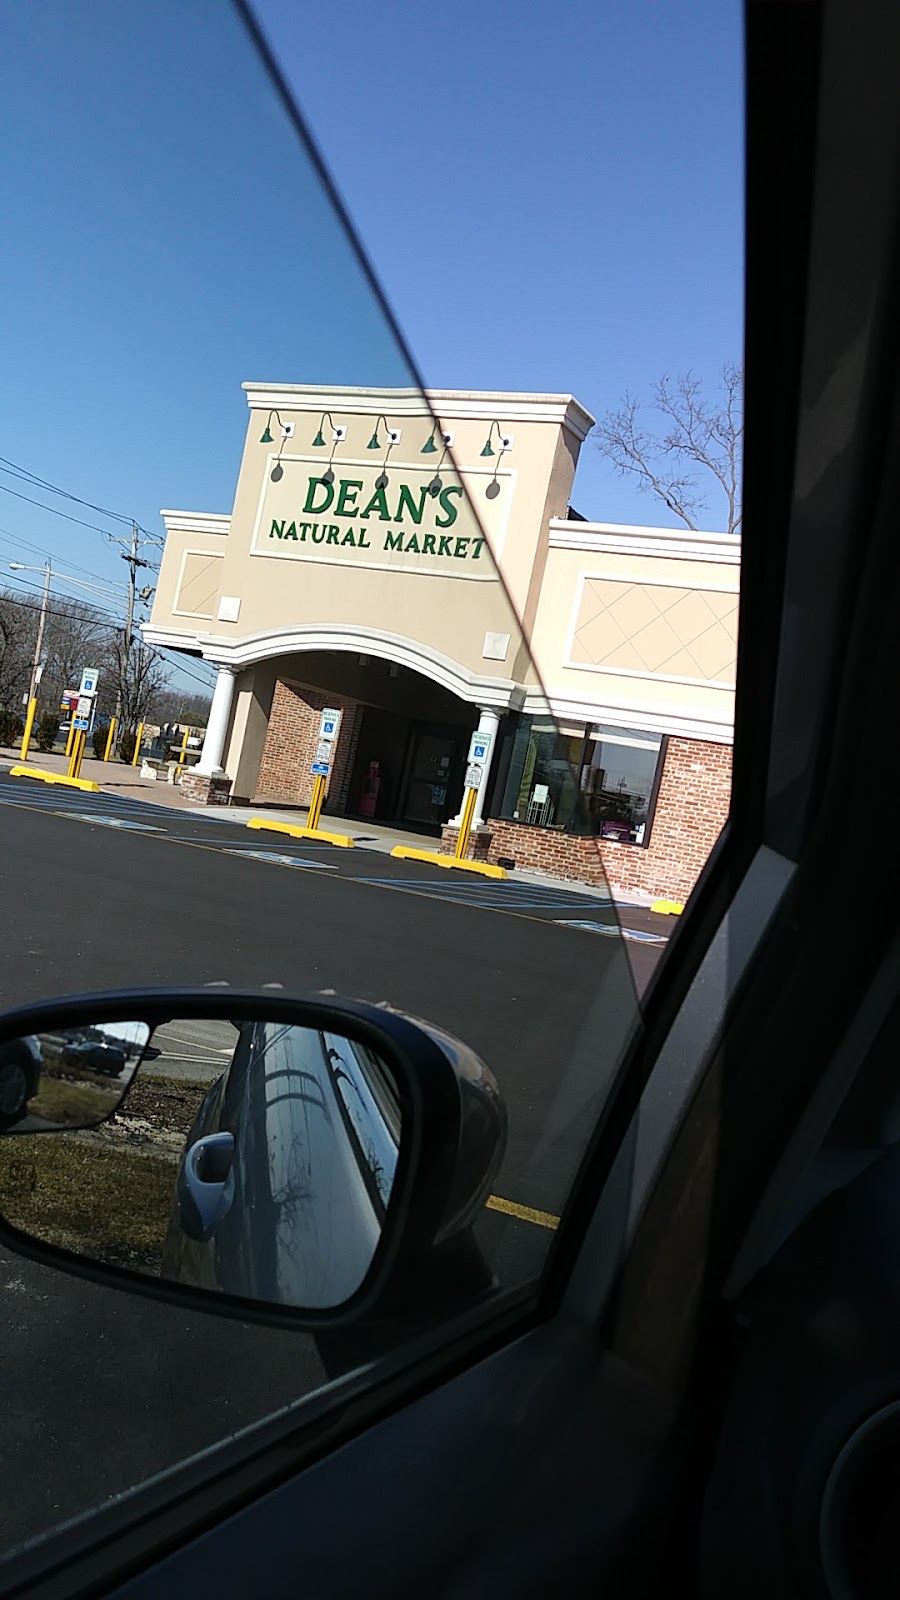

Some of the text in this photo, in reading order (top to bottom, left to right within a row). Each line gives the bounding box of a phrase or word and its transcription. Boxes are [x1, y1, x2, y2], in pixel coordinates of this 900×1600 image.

[302, 477, 463, 528] DEAN'S
[269, 519, 487, 559] NATURAL MARKET
